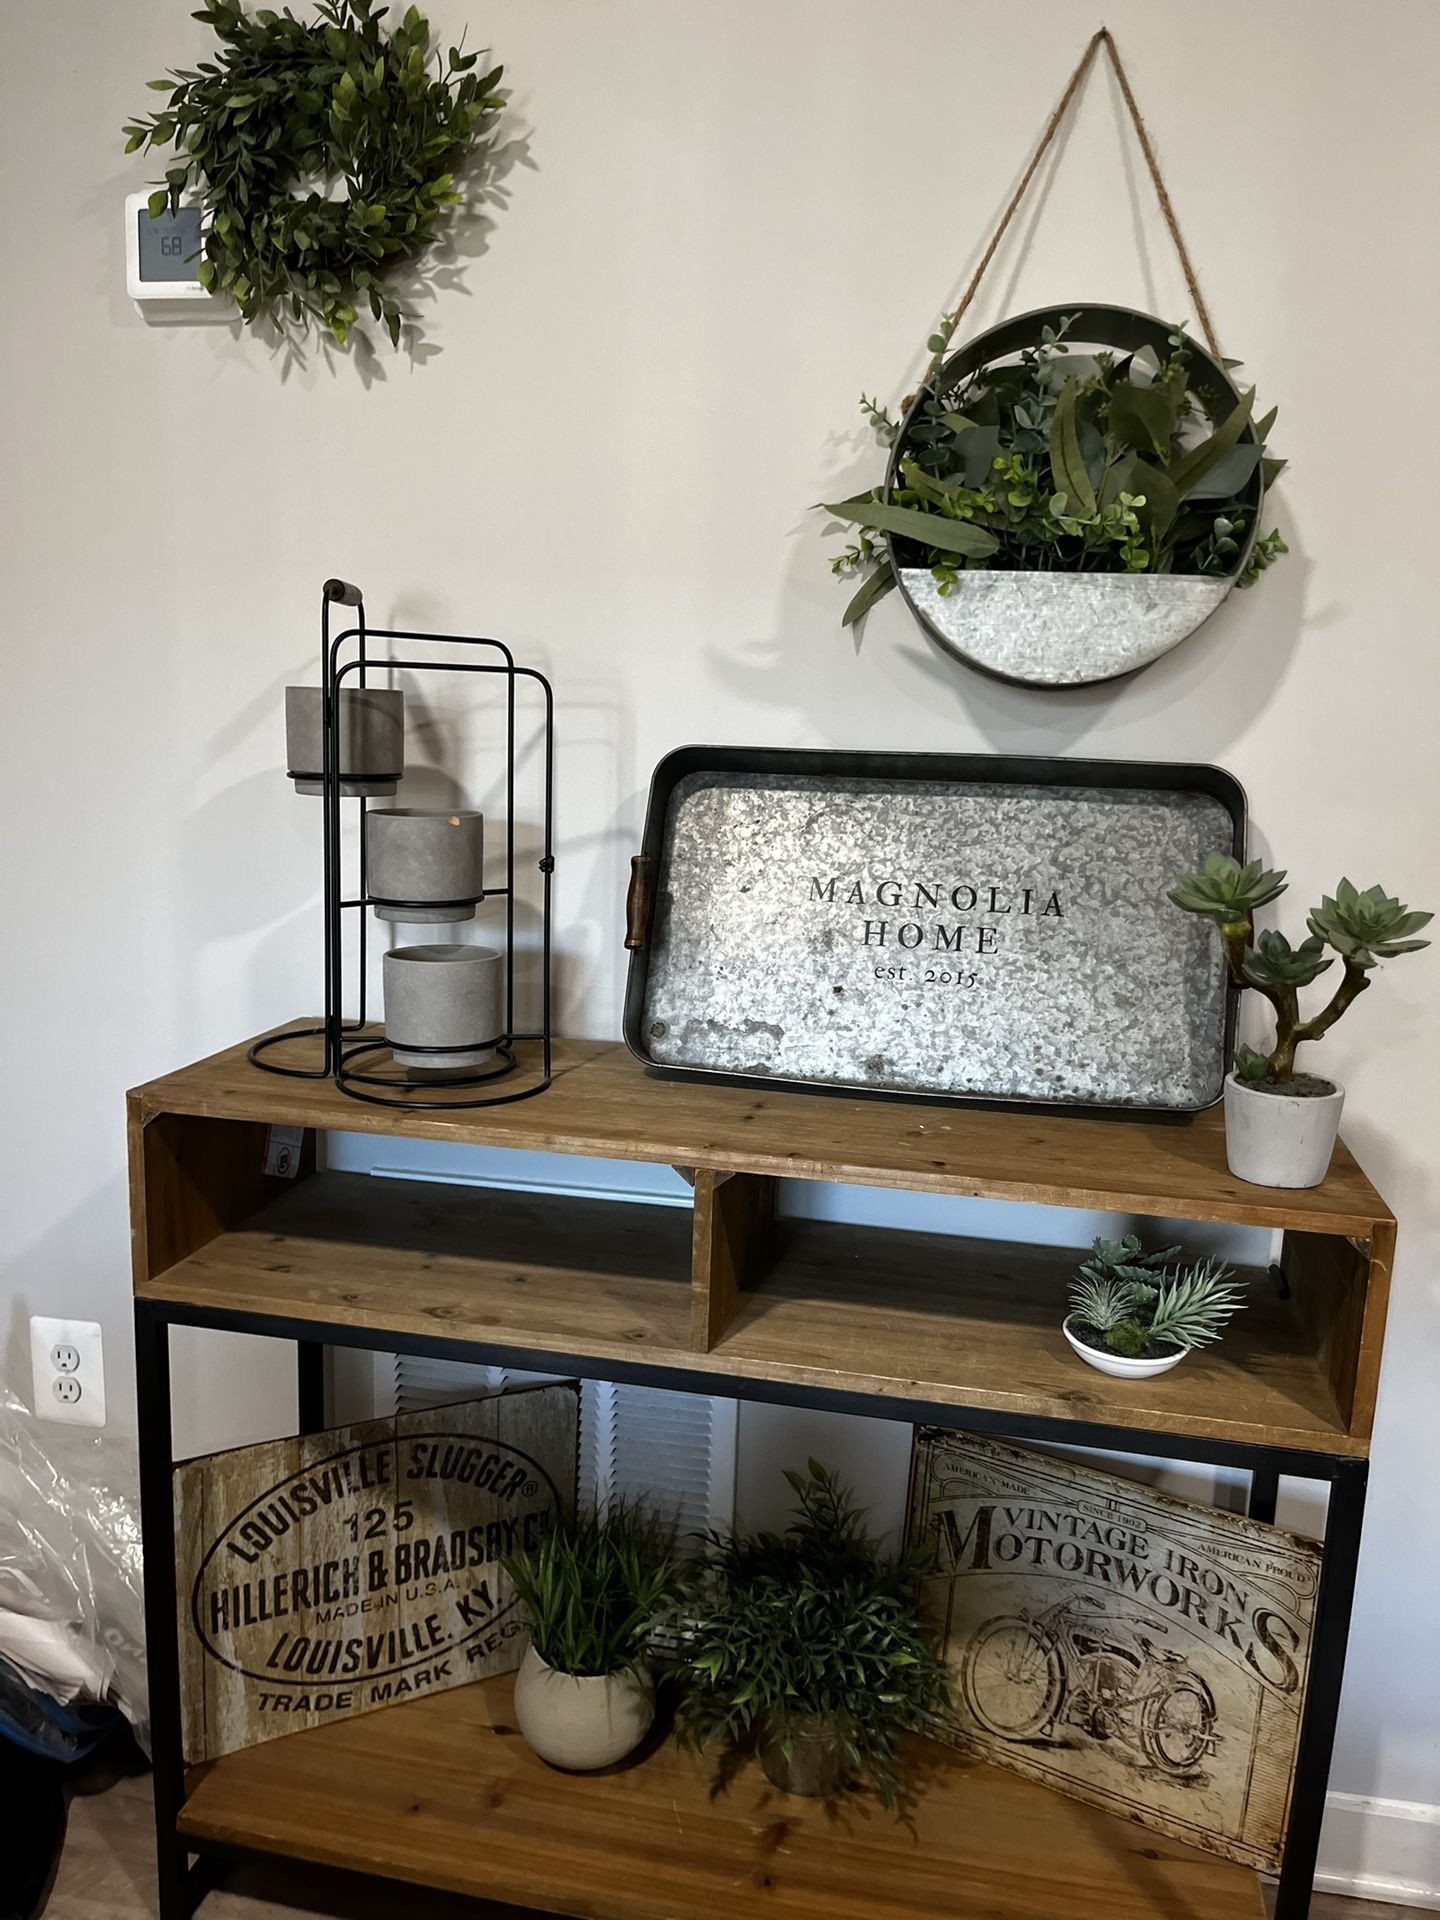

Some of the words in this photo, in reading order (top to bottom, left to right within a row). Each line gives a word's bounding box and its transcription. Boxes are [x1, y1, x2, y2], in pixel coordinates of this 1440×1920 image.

[161, 236, 182, 256] 68
[808, 876, 1065, 917] MAGNOLIA
[861, 920, 998, 954] HOME
[925, 969, 978, 988] 2015
[943, 1463, 997, 1485] AMERICAN
[1001, 1480, 1030, 1495] MADE
[227, 1450, 391, 1563] LOUISVILLE
[344, 1501, 414, 1542] 125
[1083, 1504, 1114, 1521] SINCE
[1003, 1507, 1149, 1560] VINTAGE
[1164, 1549, 1250, 1609] IRON
[1197, 1543, 1262, 1569] AMERICAN
[1265, 1562, 1306, 1583] PROUD
[210, 1557, 361, 1634] HILLERICH
[368, 1549, 389, 1592] &
[315, 1601, 372, 1625] MADE
[380, 1591, 398, 1609] IN
[930, 1505, 1300, 1695] MOTORWORKS
[257, 1691, 353, 1713] TRADE
[370, 1660, 452, 1702] MARK
